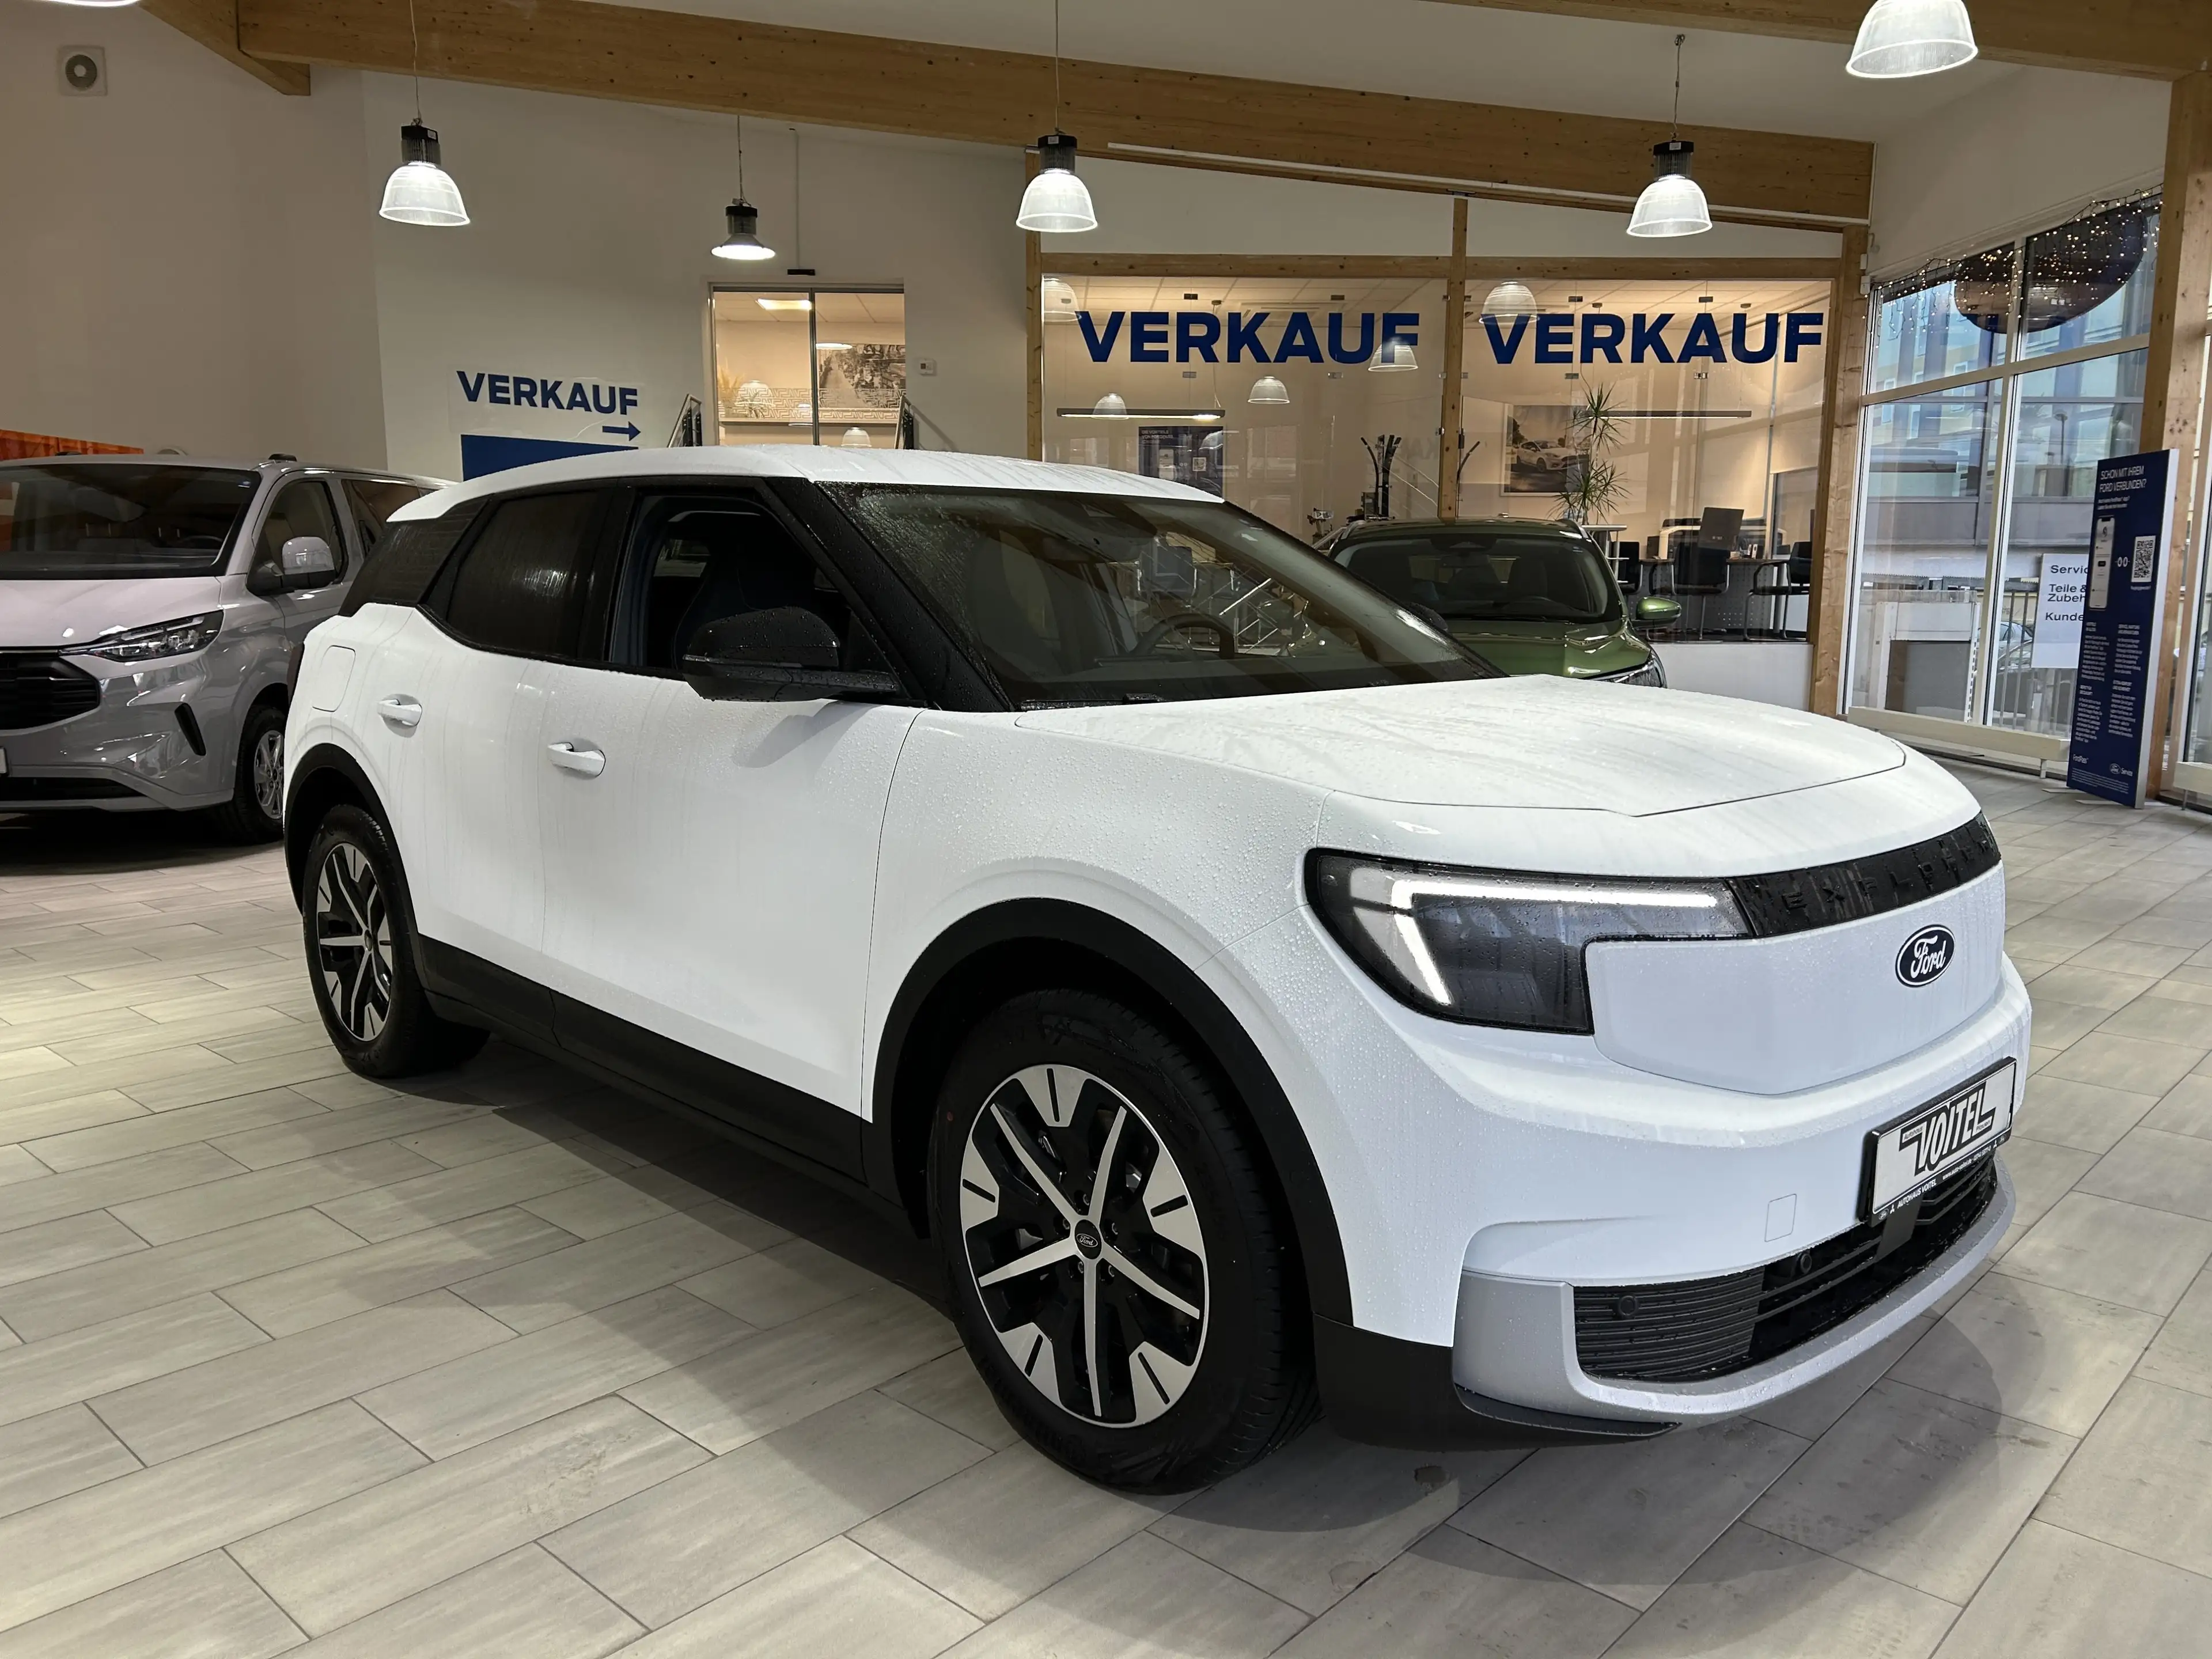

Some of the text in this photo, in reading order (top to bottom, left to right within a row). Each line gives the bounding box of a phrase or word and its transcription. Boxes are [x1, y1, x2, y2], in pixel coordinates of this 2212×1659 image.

[1074, 310, 1421, 363] VERKAUF
[1481, 312, 1825, 364] VERKAUF
[456, 370, 639, 415] VERKAUF
[2099, 482, 2113, 493] FORD
[2100, 467, 2118, 480] SCHON
[2049, 584, 2077, 592] Teile
[1917, 1086, 1986, 1169] VOITEL
[1896, 1188, 1921, 1209] AUTOHAUS
[1921, 1179, 1937, 1193] VOITEL
